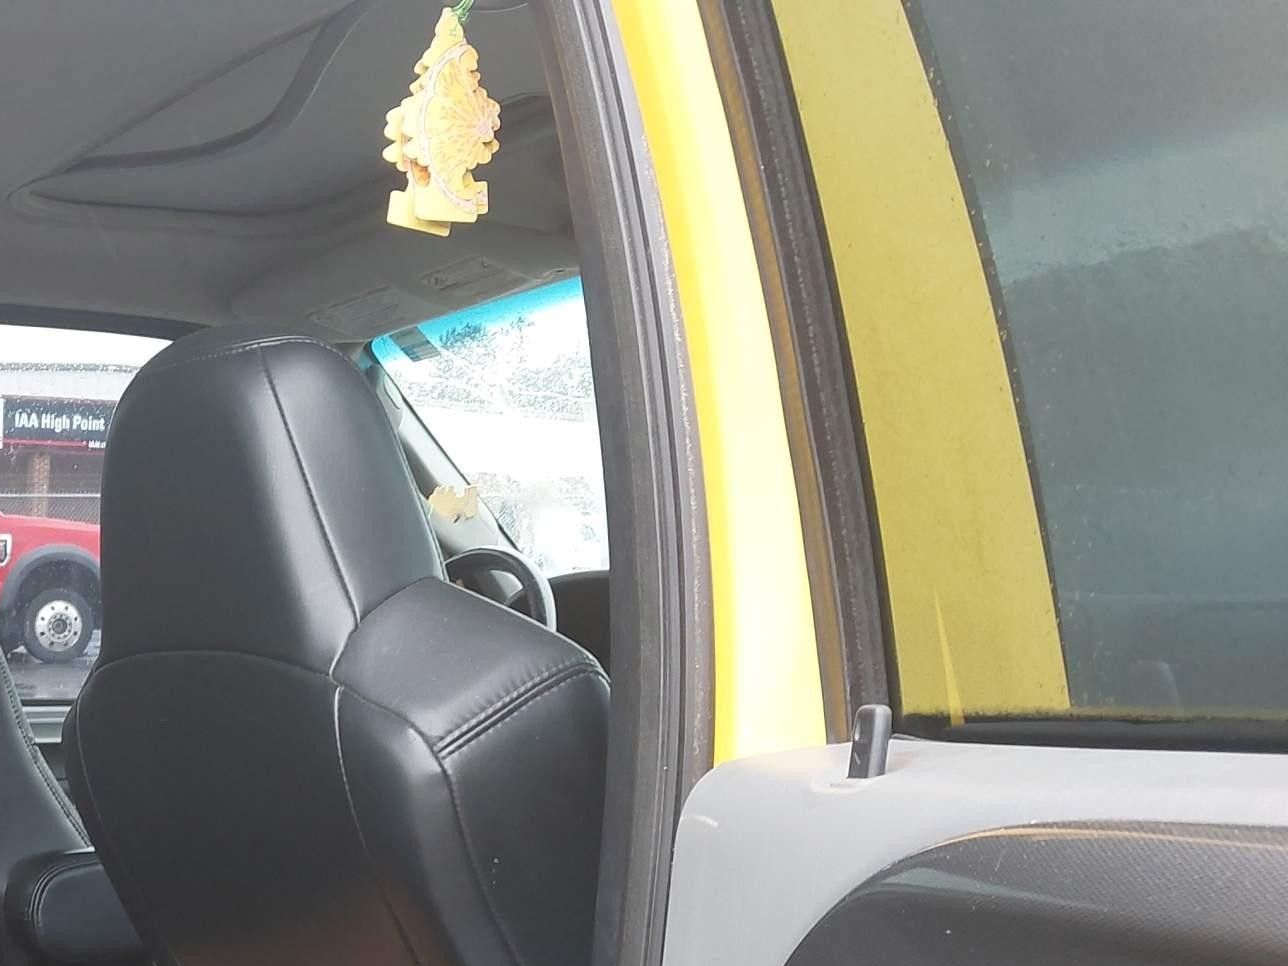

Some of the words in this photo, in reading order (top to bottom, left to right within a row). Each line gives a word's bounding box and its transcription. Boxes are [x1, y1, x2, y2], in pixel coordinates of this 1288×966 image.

[15, 411, 39, 429] IAA
[41, 414, 70, 433] High
[72, 415, 106, 432] Point
